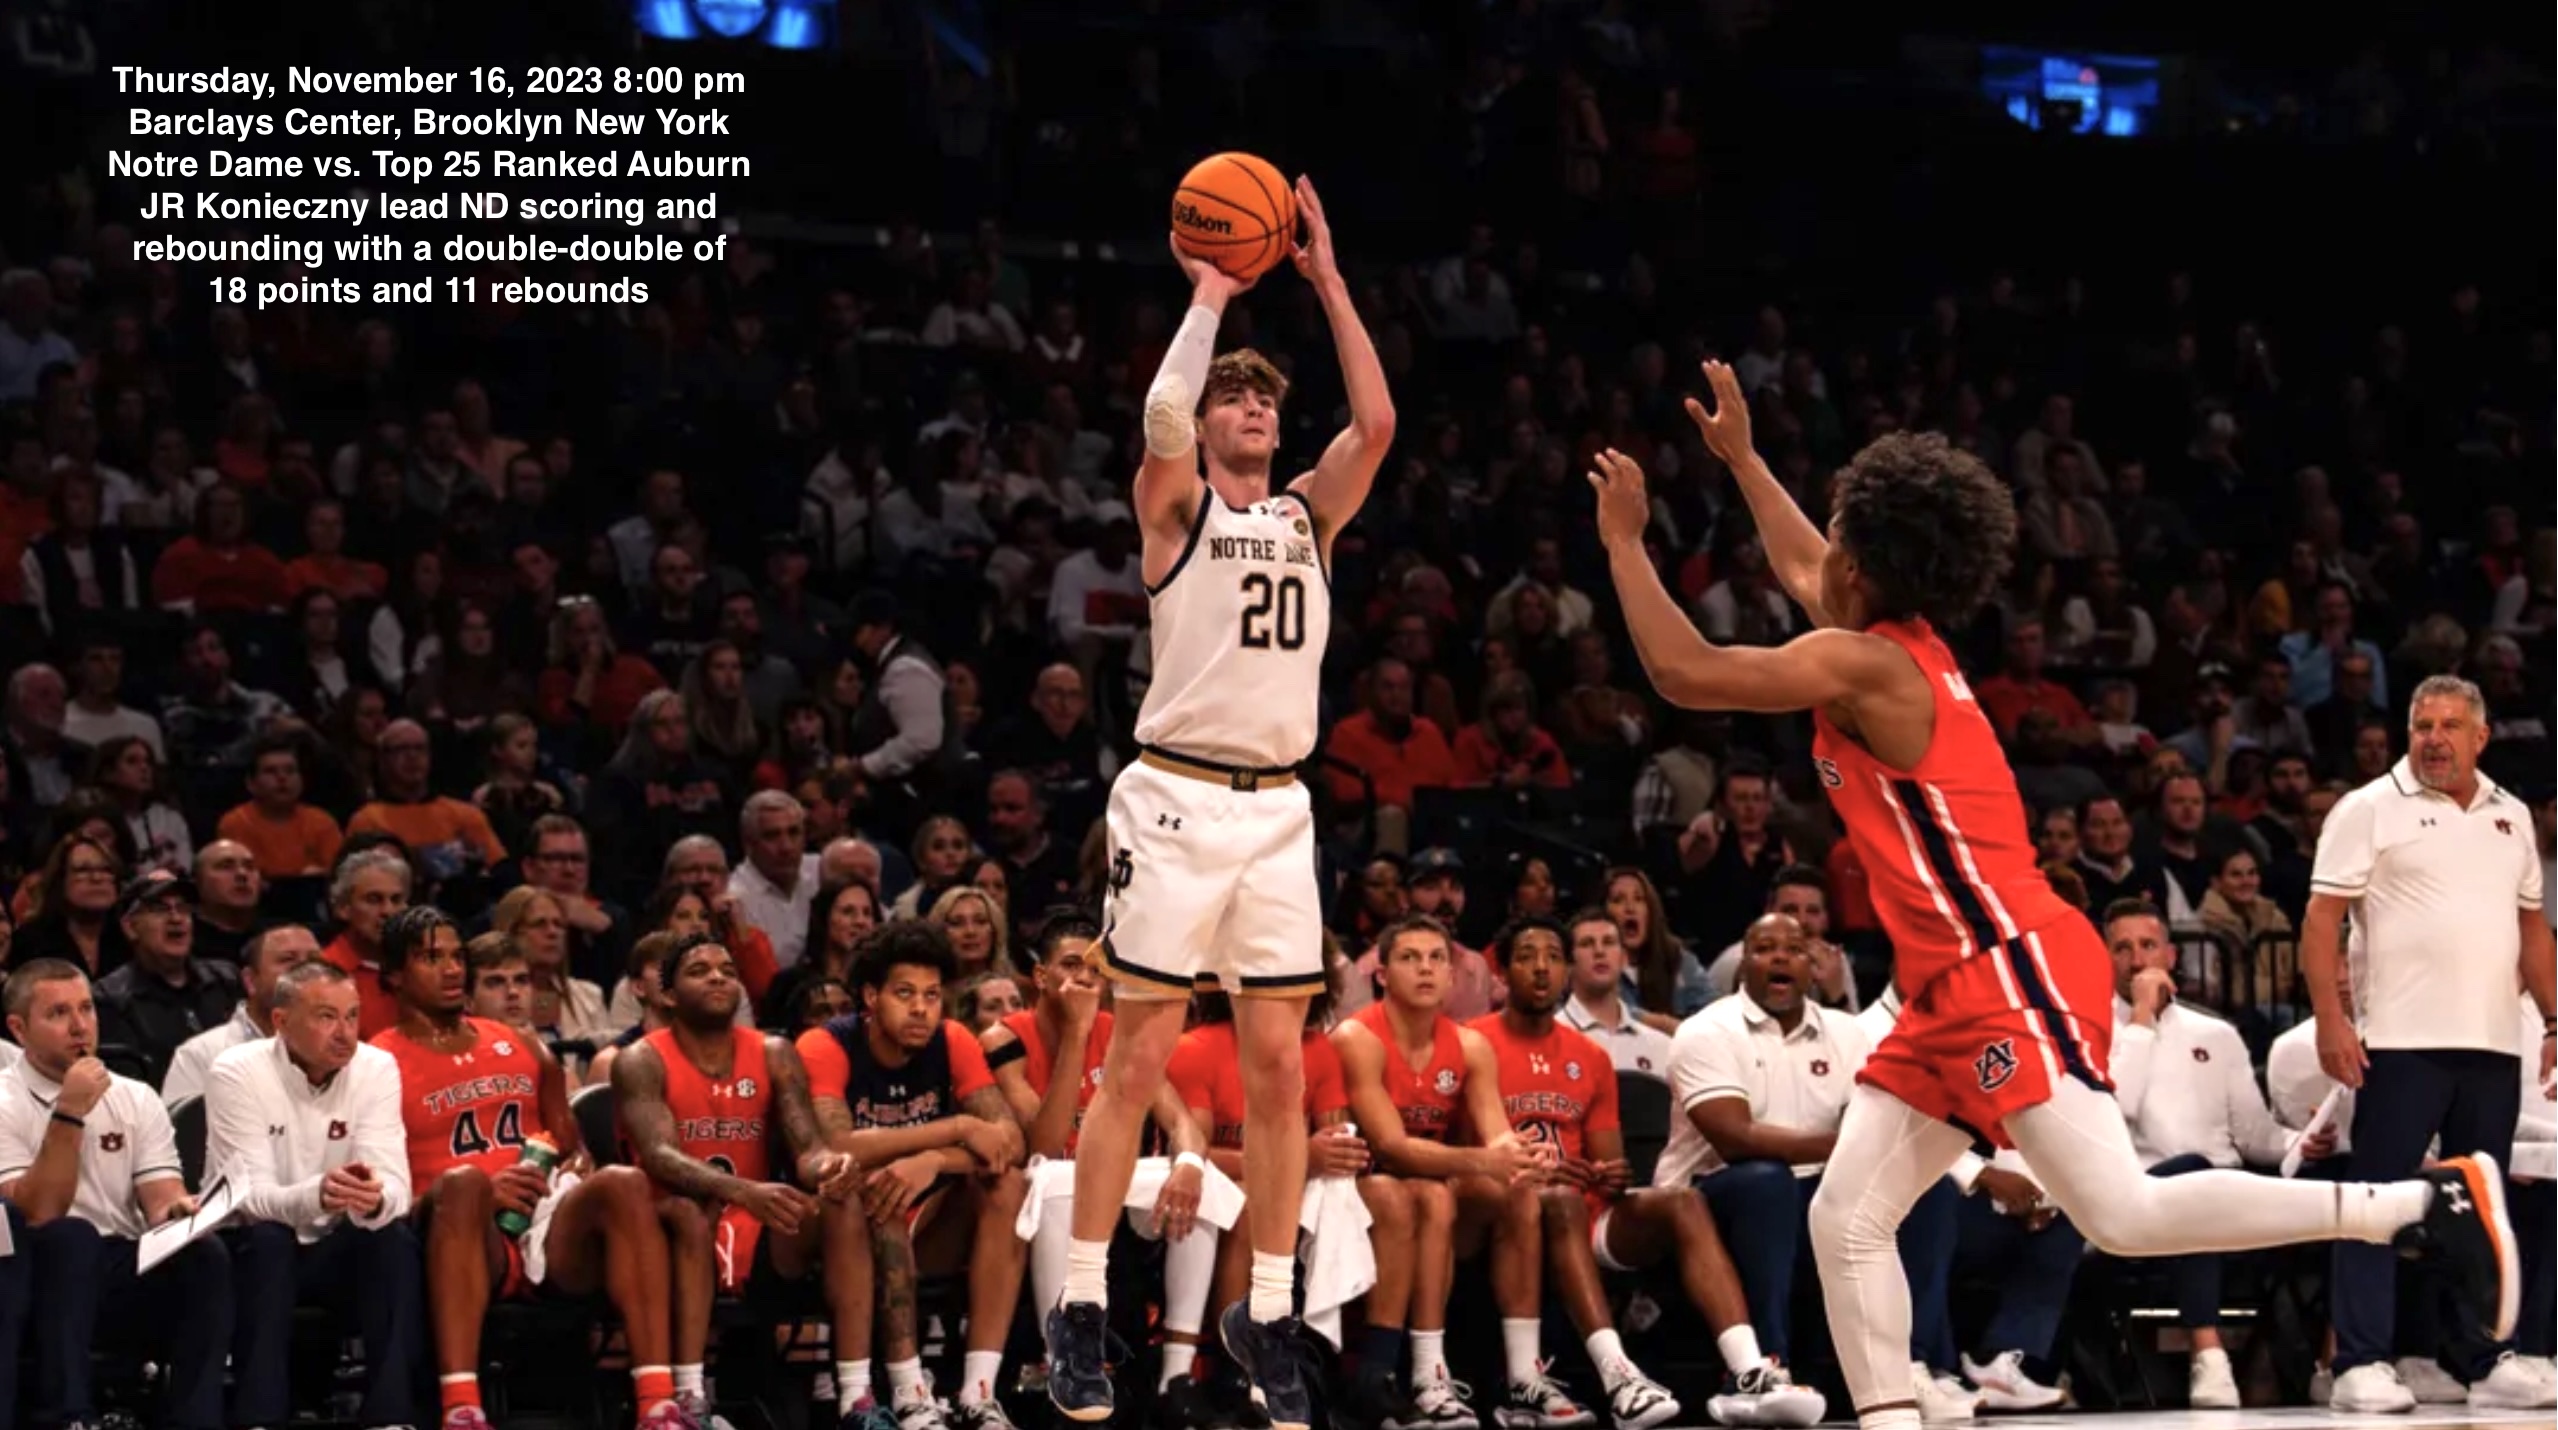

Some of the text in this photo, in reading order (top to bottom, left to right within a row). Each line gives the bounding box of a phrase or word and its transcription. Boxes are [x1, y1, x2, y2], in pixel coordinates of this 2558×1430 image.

[1210, 537, 1276, 562] NOTRE
[1240, 573, 1305, 651] 20
[423, 1074, 535, 1115] TIGERS
[452, 1101, 527, 1156] 44
